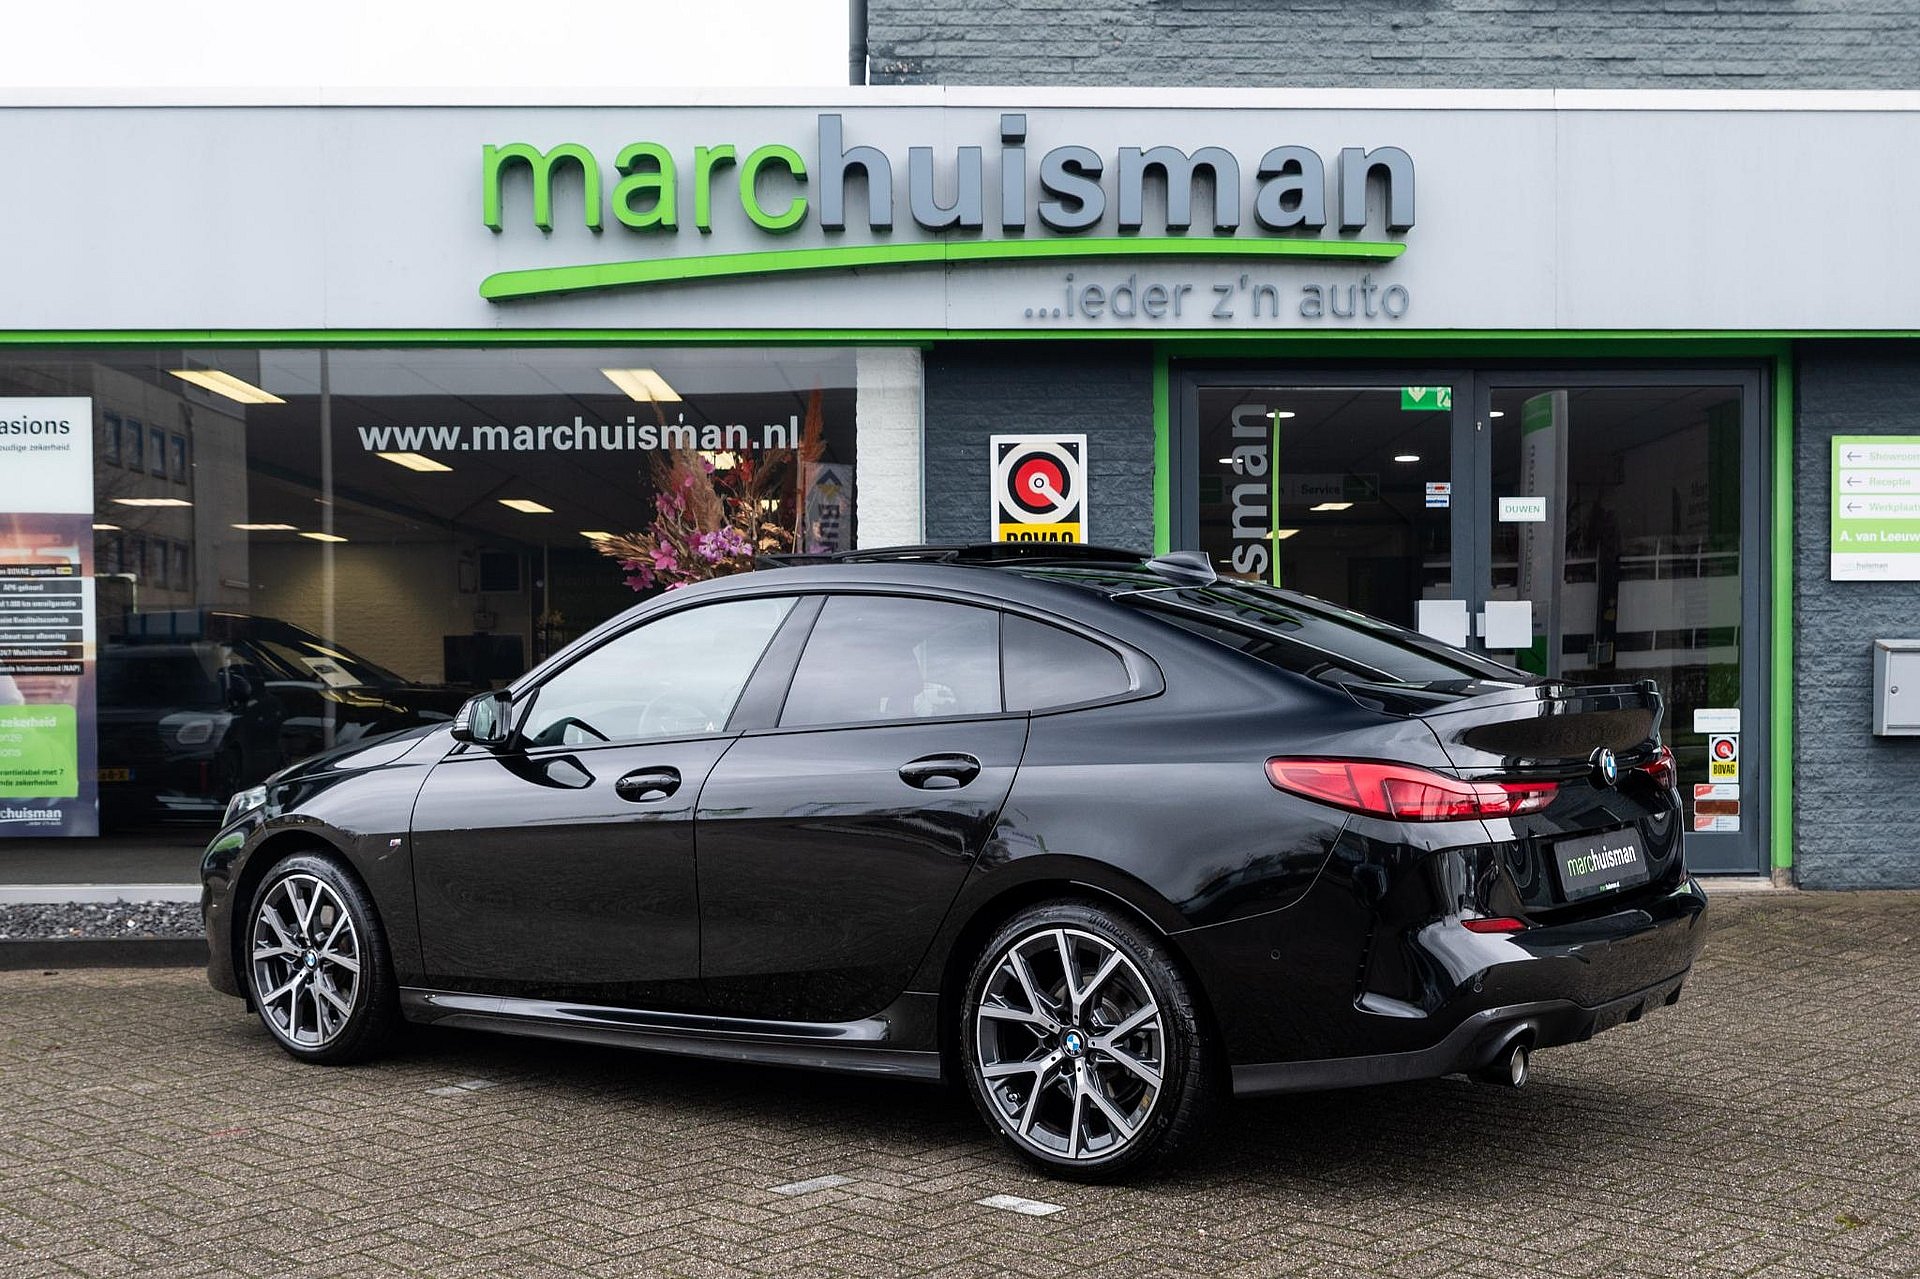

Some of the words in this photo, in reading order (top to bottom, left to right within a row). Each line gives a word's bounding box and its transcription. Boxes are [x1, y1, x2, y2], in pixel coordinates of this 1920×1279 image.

[483, 113, 1417, 234] marchuisman
[1024, 273, 1192, 319] ...ieder
[1211, 274, 1280, 319] z'n
[1299, 274, 1410, 319] auto
[358, 415, 799, 451] www.marchuisman.nl
[1231, 404, 1268, 576] sman
[1869, 477, 1911, 489] Receptie
[1839, 530, 1852, 542] A.
[1855, 532, 1876, 542] van
[1713, 764, 1735, 775] BOVAG
[1567, 845, 1637, 877] marchuisman
